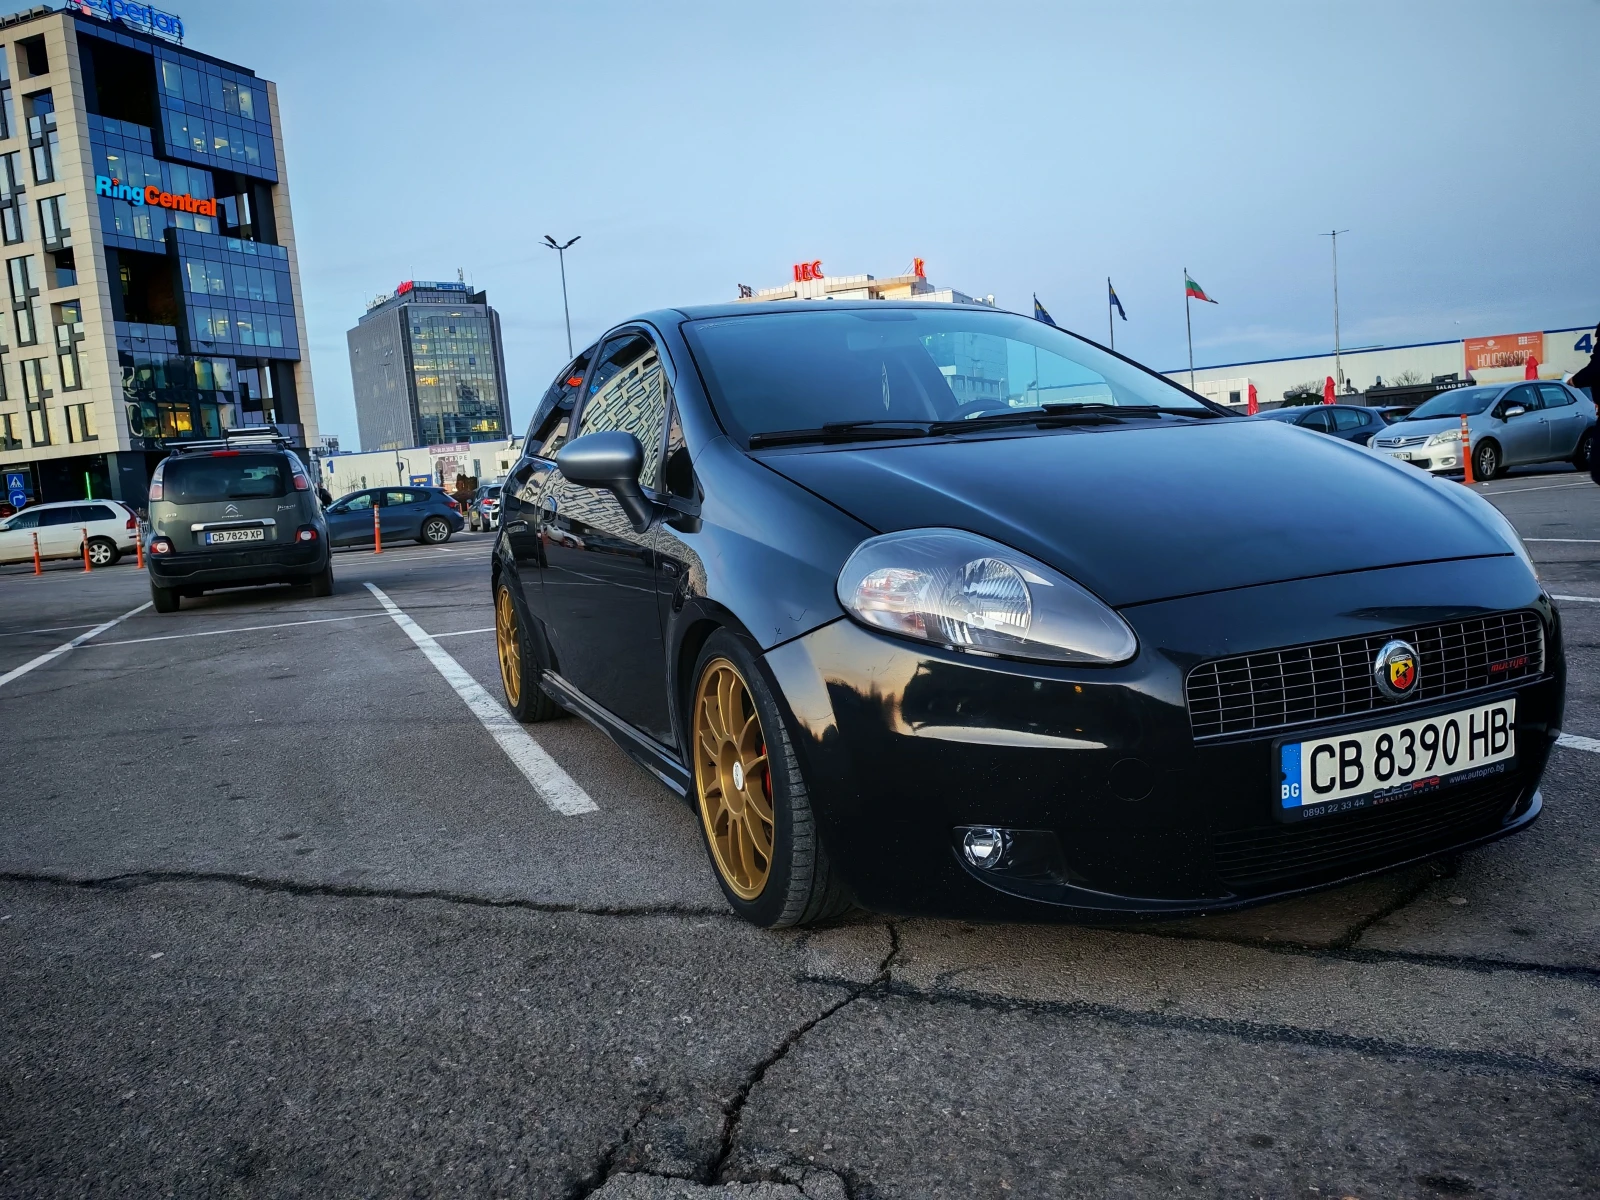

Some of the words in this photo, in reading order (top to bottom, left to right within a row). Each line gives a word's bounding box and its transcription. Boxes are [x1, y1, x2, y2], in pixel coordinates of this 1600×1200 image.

[96, 175, 217, 217] RingCentral
[794, 261, 824, 282] IEC
[1574, 333, 1593, 354] 4
[327, 460, 334, 474] 1
[212, 533, 224, 542] CB
[226, 531, 249, 541] 7829
[250, 530, 262, 539] XP
[1309, 739, 1364, 794] CB
[1373, 718, 1461, 782] 8390
[1468, 707, 1509, 761] HB
[1449, 763, 1505, 784] www.autopro.bg
[1281, 783, 1300, 800] BG
[1303, 806, 1325, 818] 0893
[1328, 804, 1339, 813] 22
[1341, 801, 1352, 810] 33
[1354, 799, 1365, 807] 44
